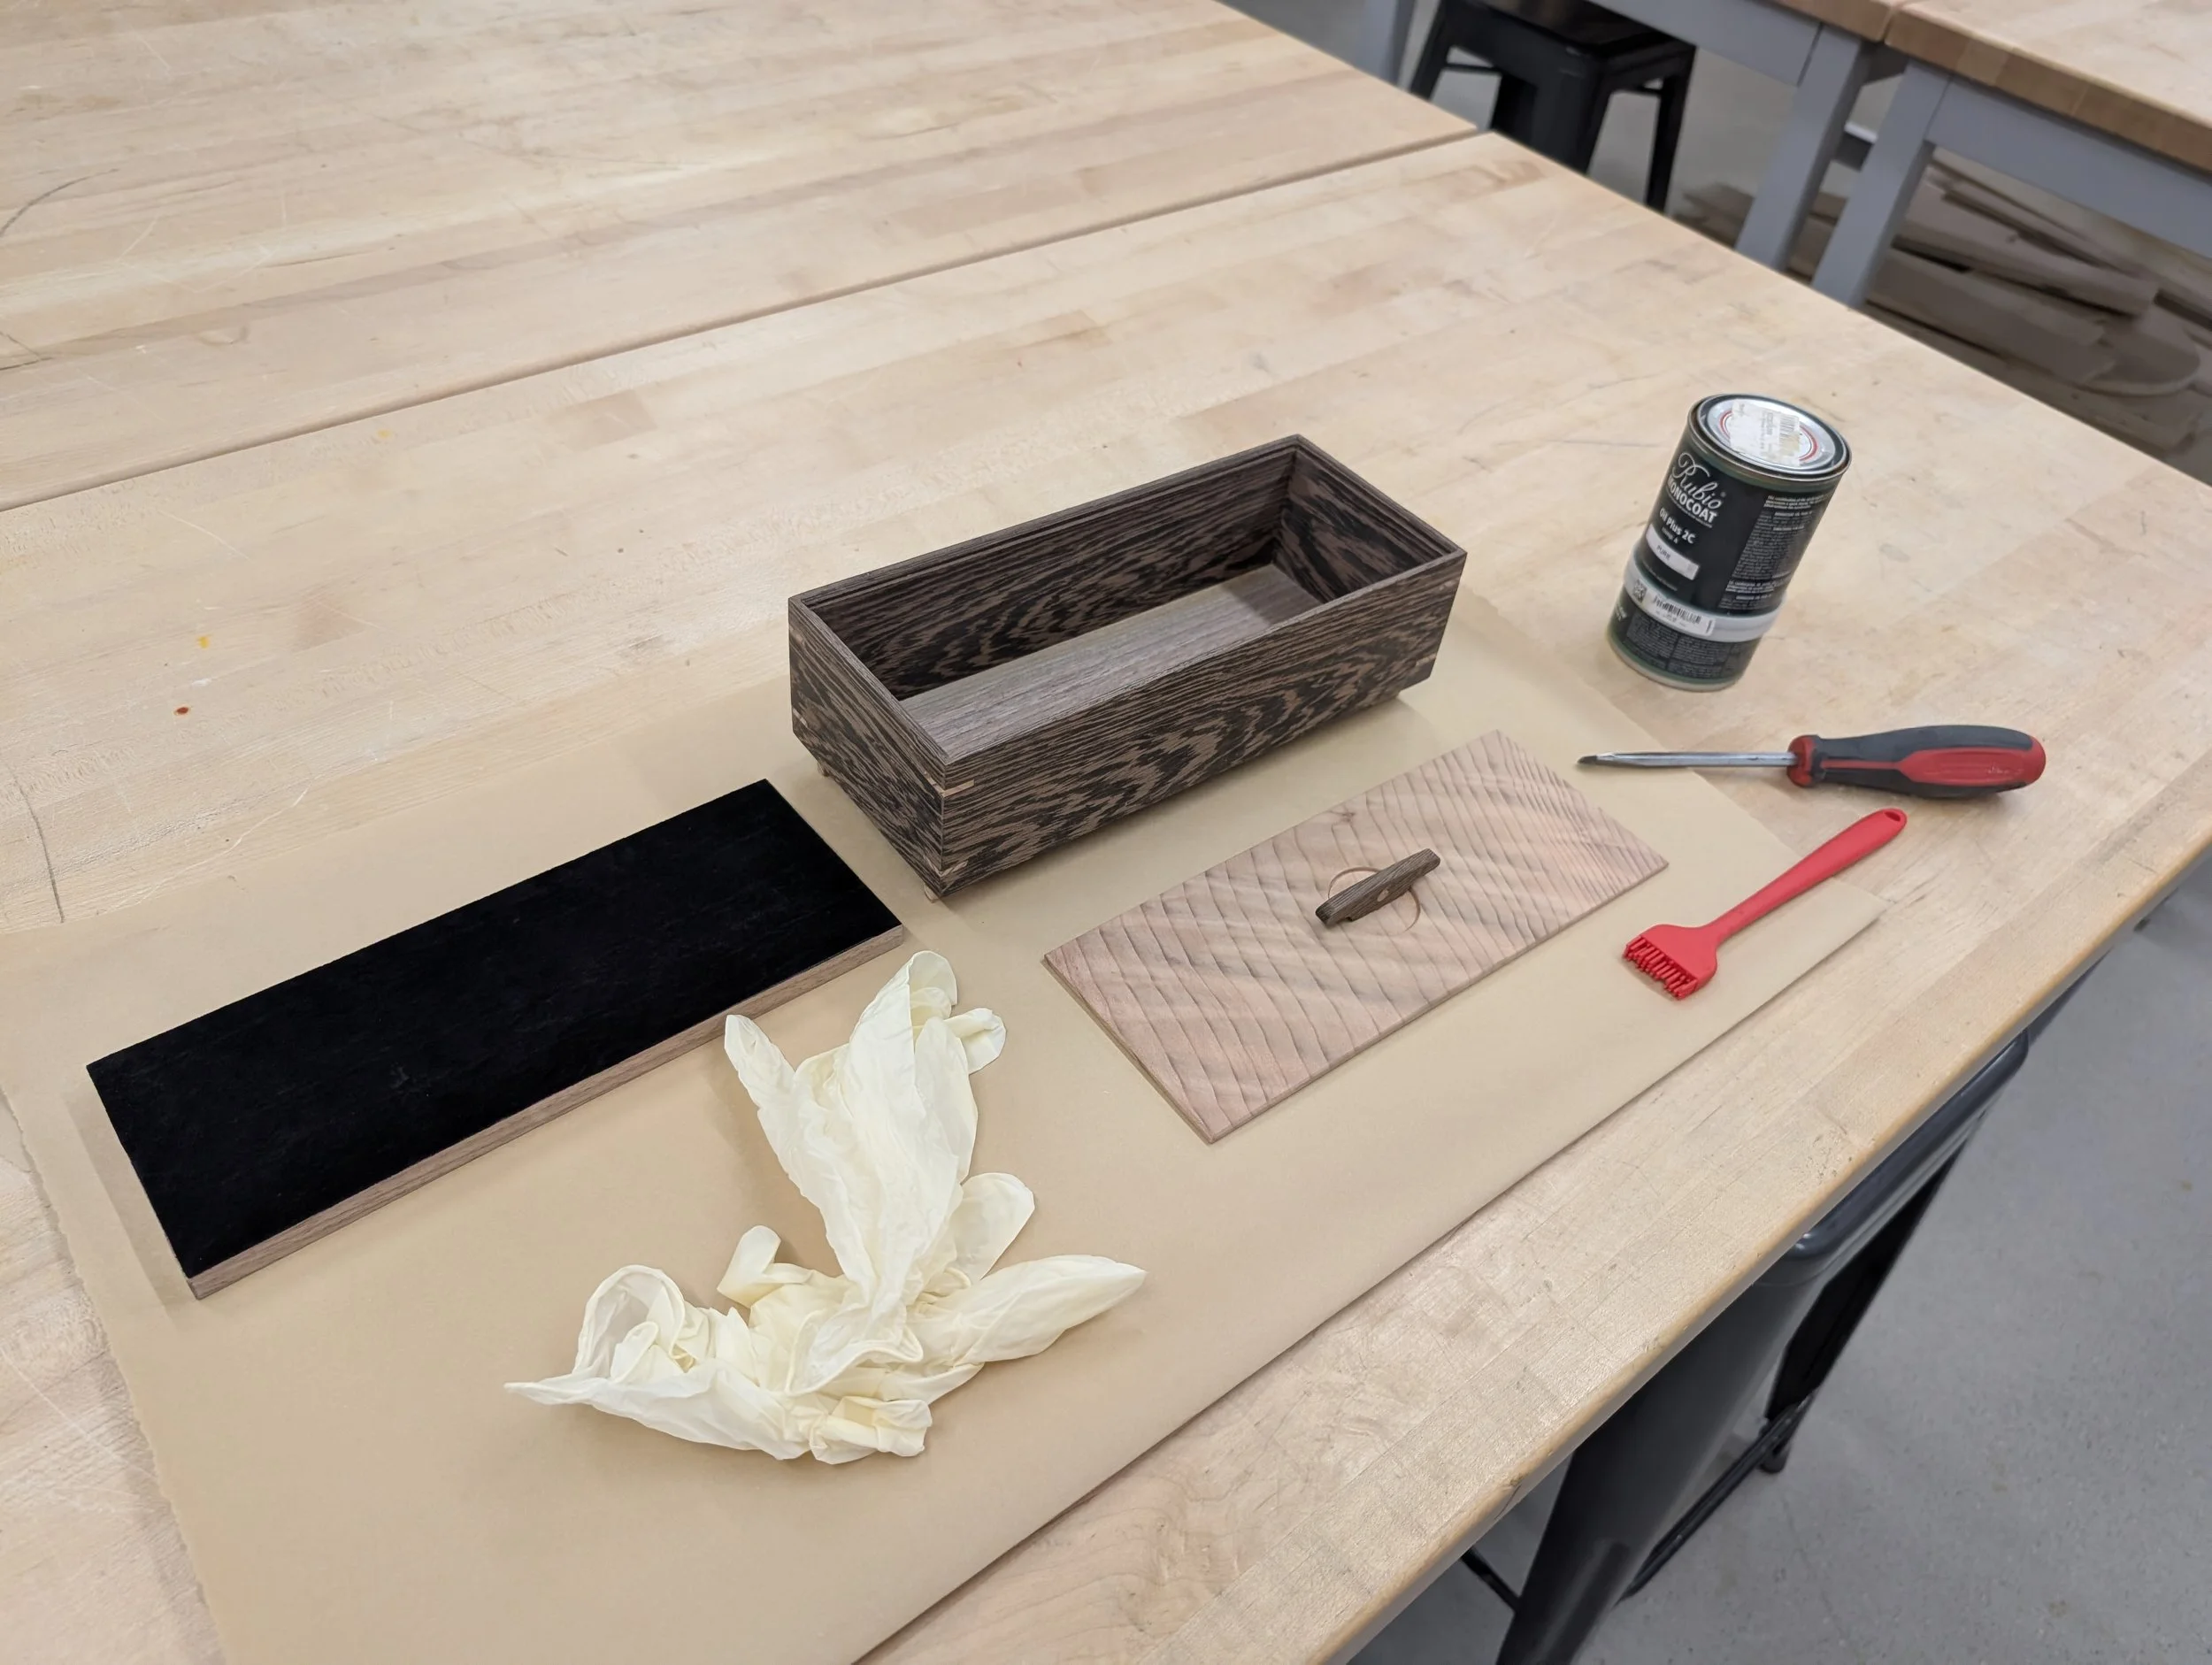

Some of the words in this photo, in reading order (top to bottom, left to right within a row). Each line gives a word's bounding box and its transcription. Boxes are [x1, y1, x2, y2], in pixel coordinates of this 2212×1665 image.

[1672, 452, 1722, 510] Rubio
[1666, 517, 1682, 536] Plus
[1681, 529, 1696, 544] 2C
